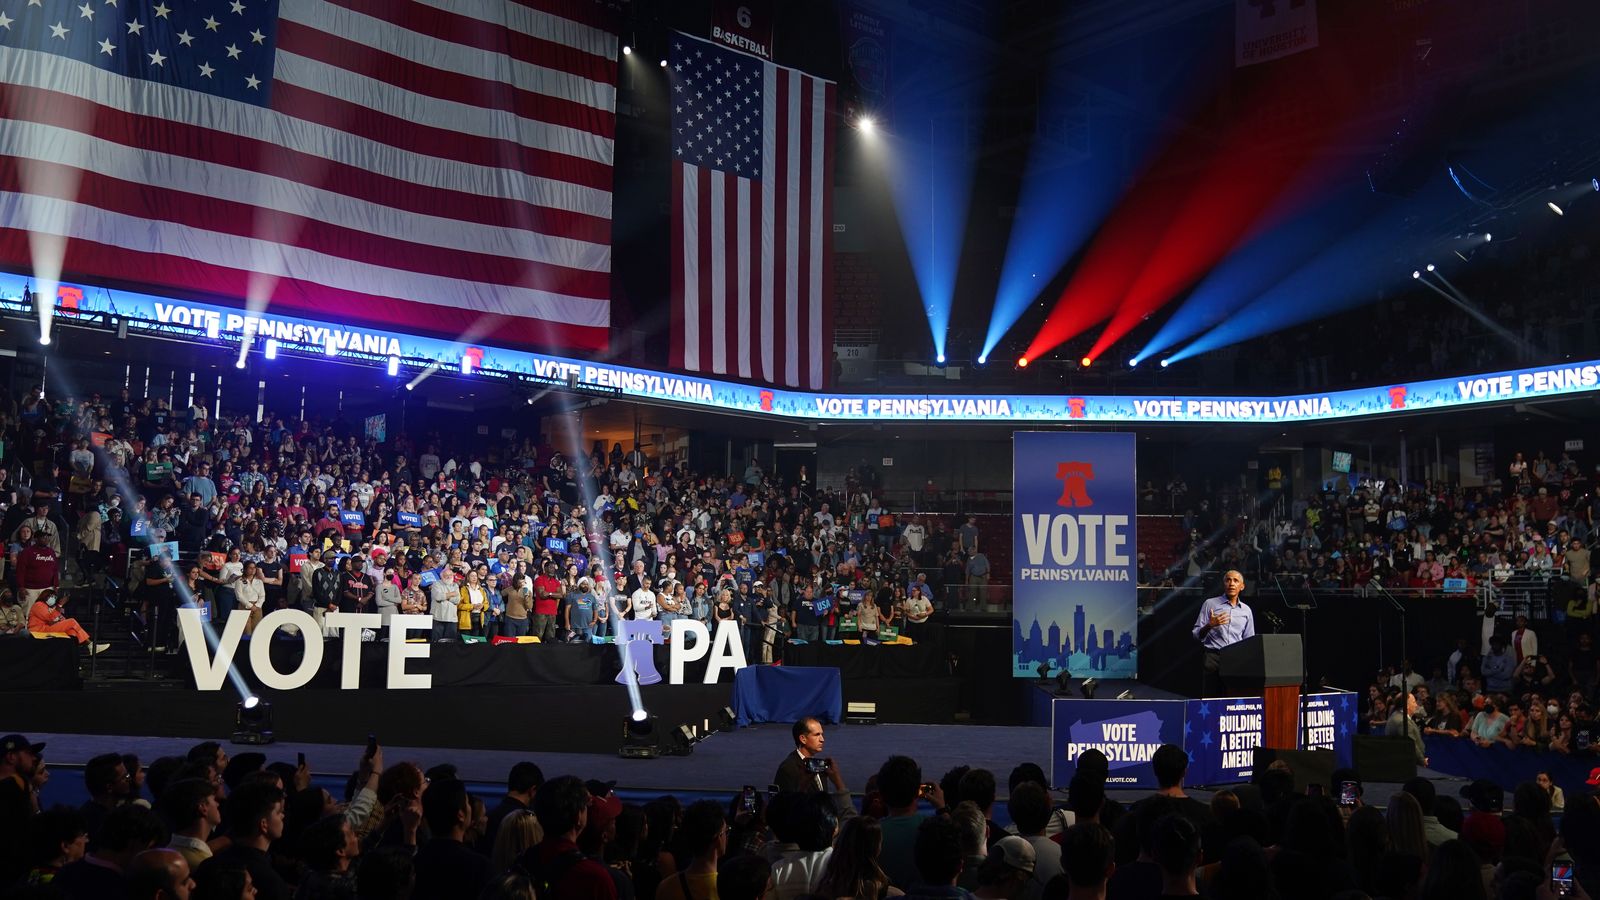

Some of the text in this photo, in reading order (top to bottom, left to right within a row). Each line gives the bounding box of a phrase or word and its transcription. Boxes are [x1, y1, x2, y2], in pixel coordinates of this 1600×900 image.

[736, 6, 752, 29] 6
[847, 349, 859, 357] 210
[584, 366, 714, 402] PENNSYLVANIA
[1457, 376, 1514, 400] VOTE
[815, 397, 1011, 416] VOTE PENNSYLVANIA
[1133, 397, 1333, 418] VOTE PENNSYLVANIA
[344, 513, 362, 521] VOTE!
[401, 514, 418, 523] VOTE!
[549, 540, 565, 549] USA
[1021, 513, 1130, 566] VOTE
[1021, 568, 1130, 581] PENNSYLVANIA
[816, 599, 832, 612] USA
[176, 607, 748, 692] VOTE PA
[1219, 713, 1262, 733] BUILDING
[1301, 709, 1335, 728] UILDING
[1102, 723, 1137, 742] VOTE
[1220, 731, 1262, 751] A BETTER
[1308, 726, 1335, 745] BETTER
